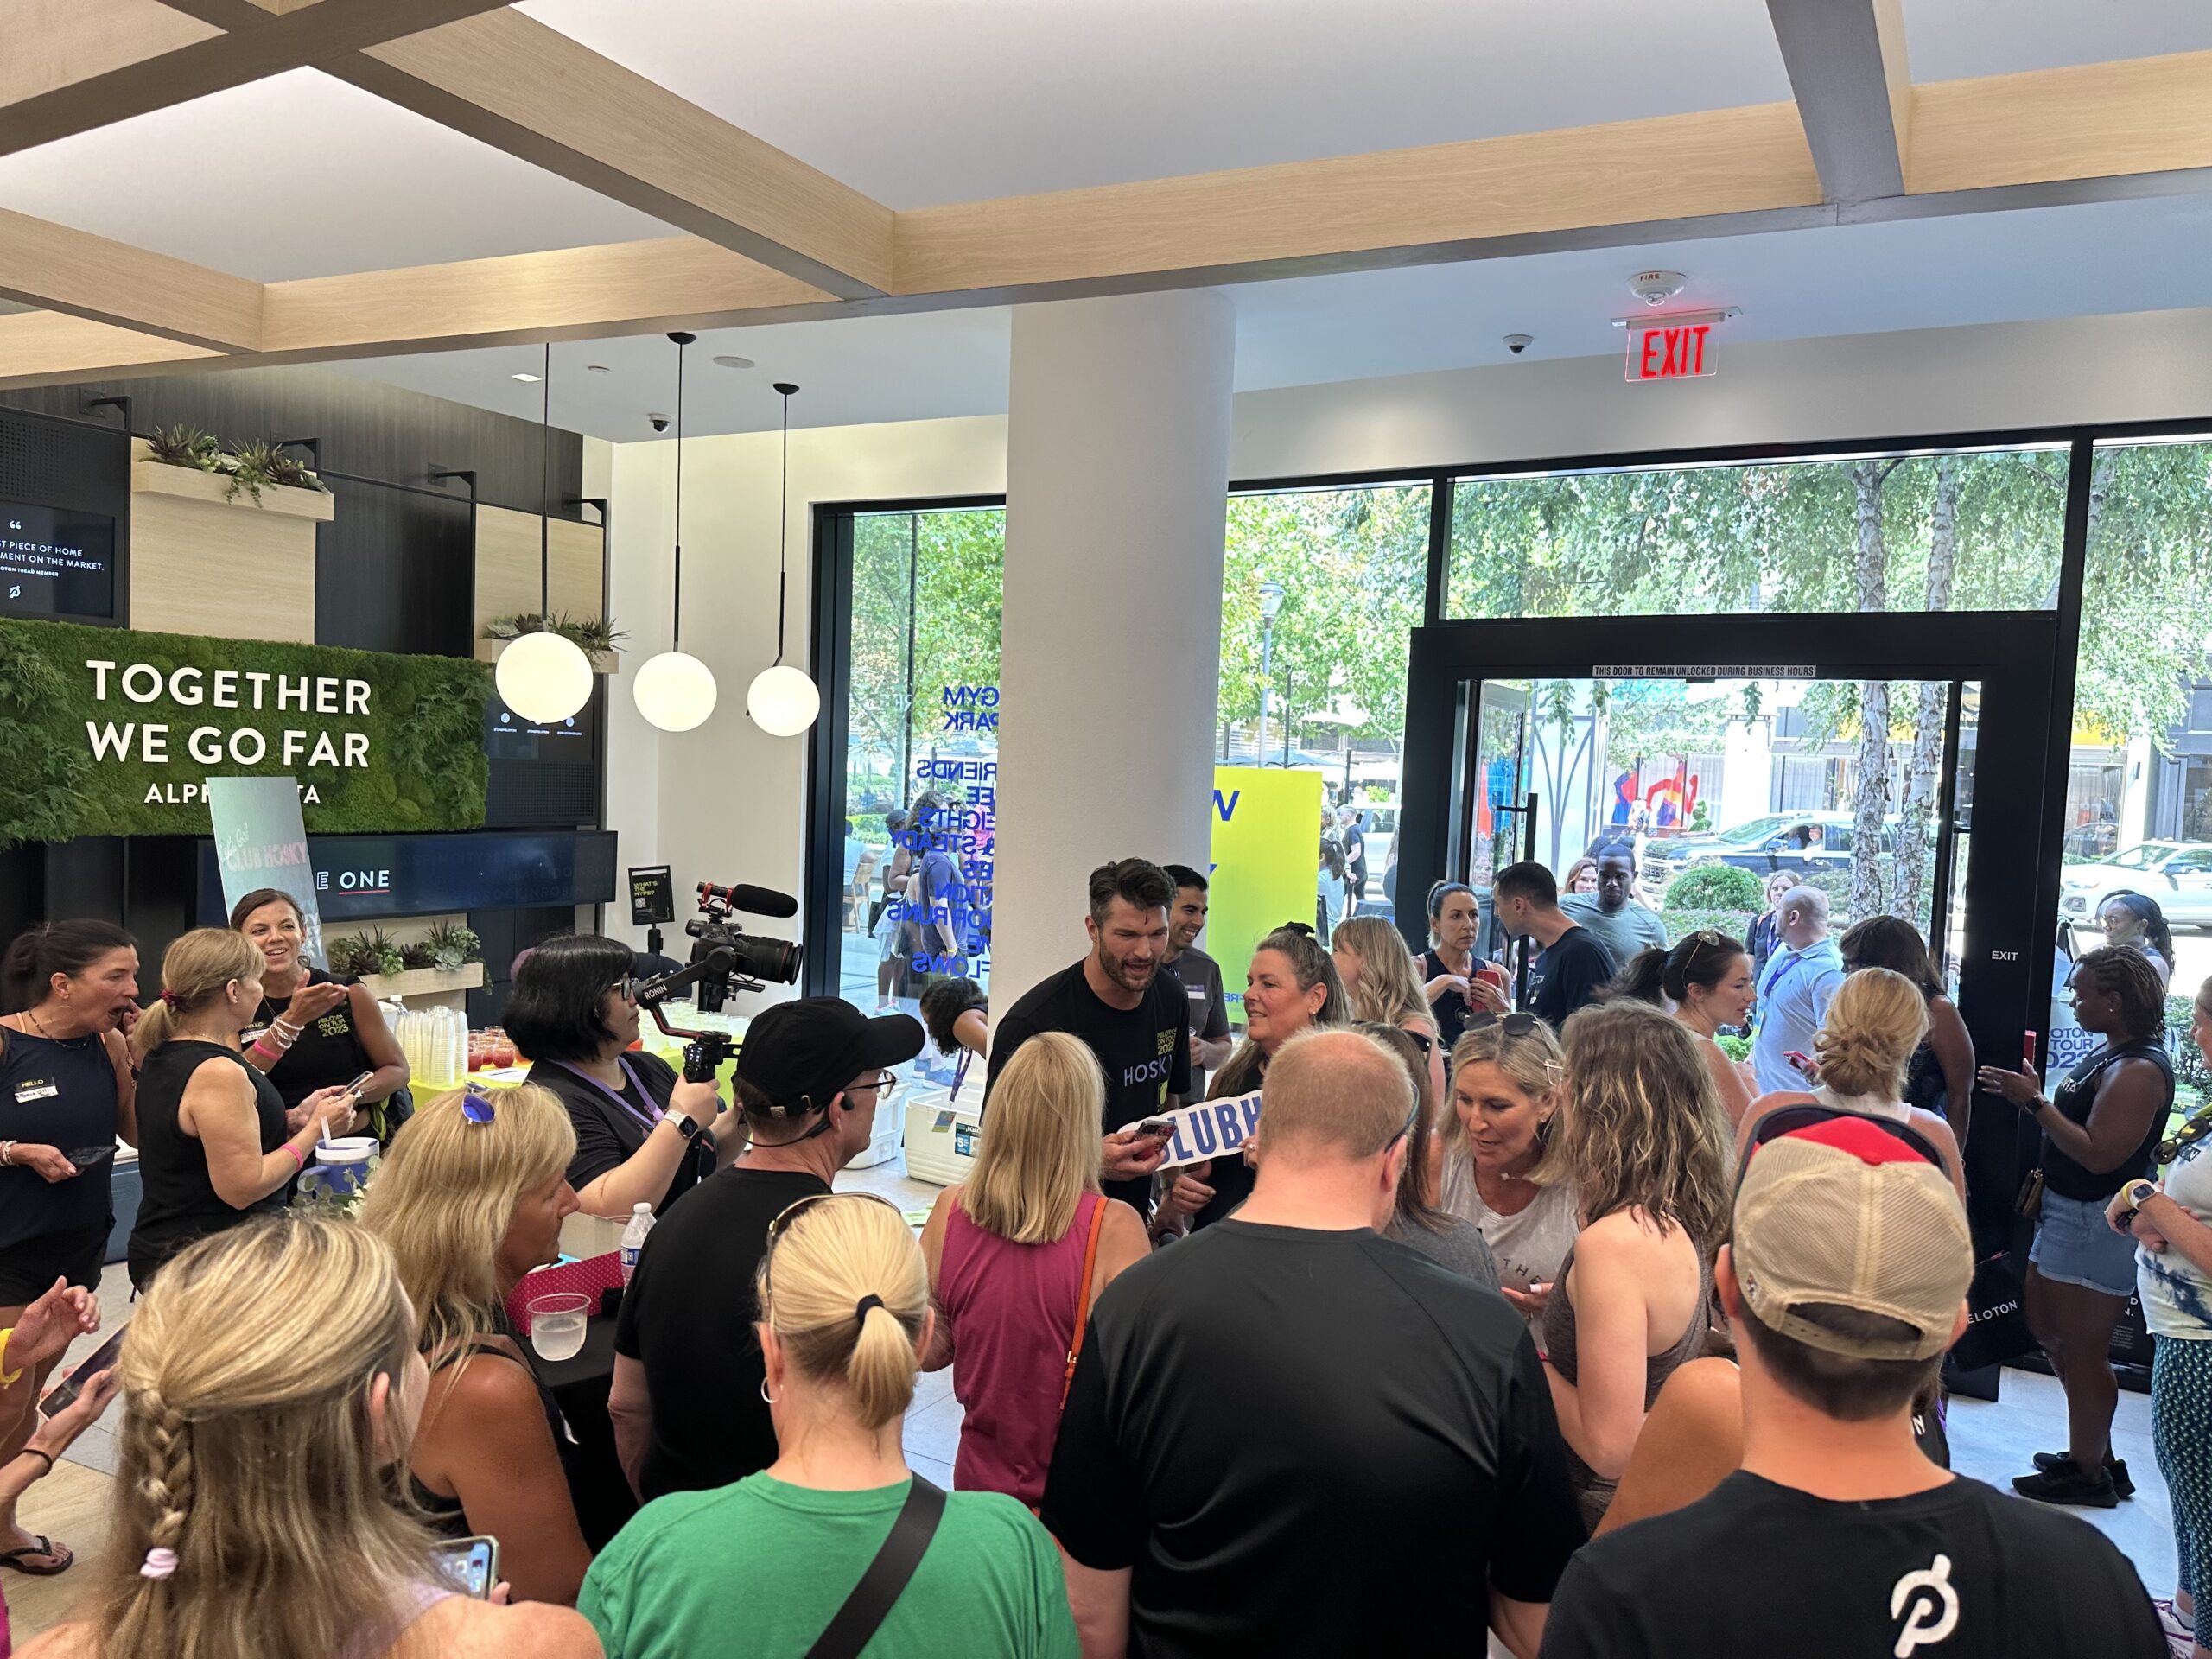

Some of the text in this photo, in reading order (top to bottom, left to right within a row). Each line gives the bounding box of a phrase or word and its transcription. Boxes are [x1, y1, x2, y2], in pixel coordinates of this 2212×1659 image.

[1640, 326, 1710, 378] EXIT
[10, 541, 36, 551] PIECE
[55, 547, 83, 557] HOME
[47, 556, 64, 566] THE
[67, 560, 105, 571] MARKET.
[1595, 666, 1814, 676] THIS DOOR TO REMAIN UNLOCKED DURING BUSINESS HOURS
[86, 659, 372, 715] TOGETHER
[86, 721, 371, 768] WE GO FAR
[262, 842, 308, 869] HOSKY
[339, 869, 390, 889] ONE
[1991, 950, 2019, 962] EXIT
[644, 983, 668, 1001] RONIN
[321, 1023, 349, 1037] 2023
[2049, 1039, 2094, 1051] TOUR
[21, 1078, 44, 1089] HELLO
